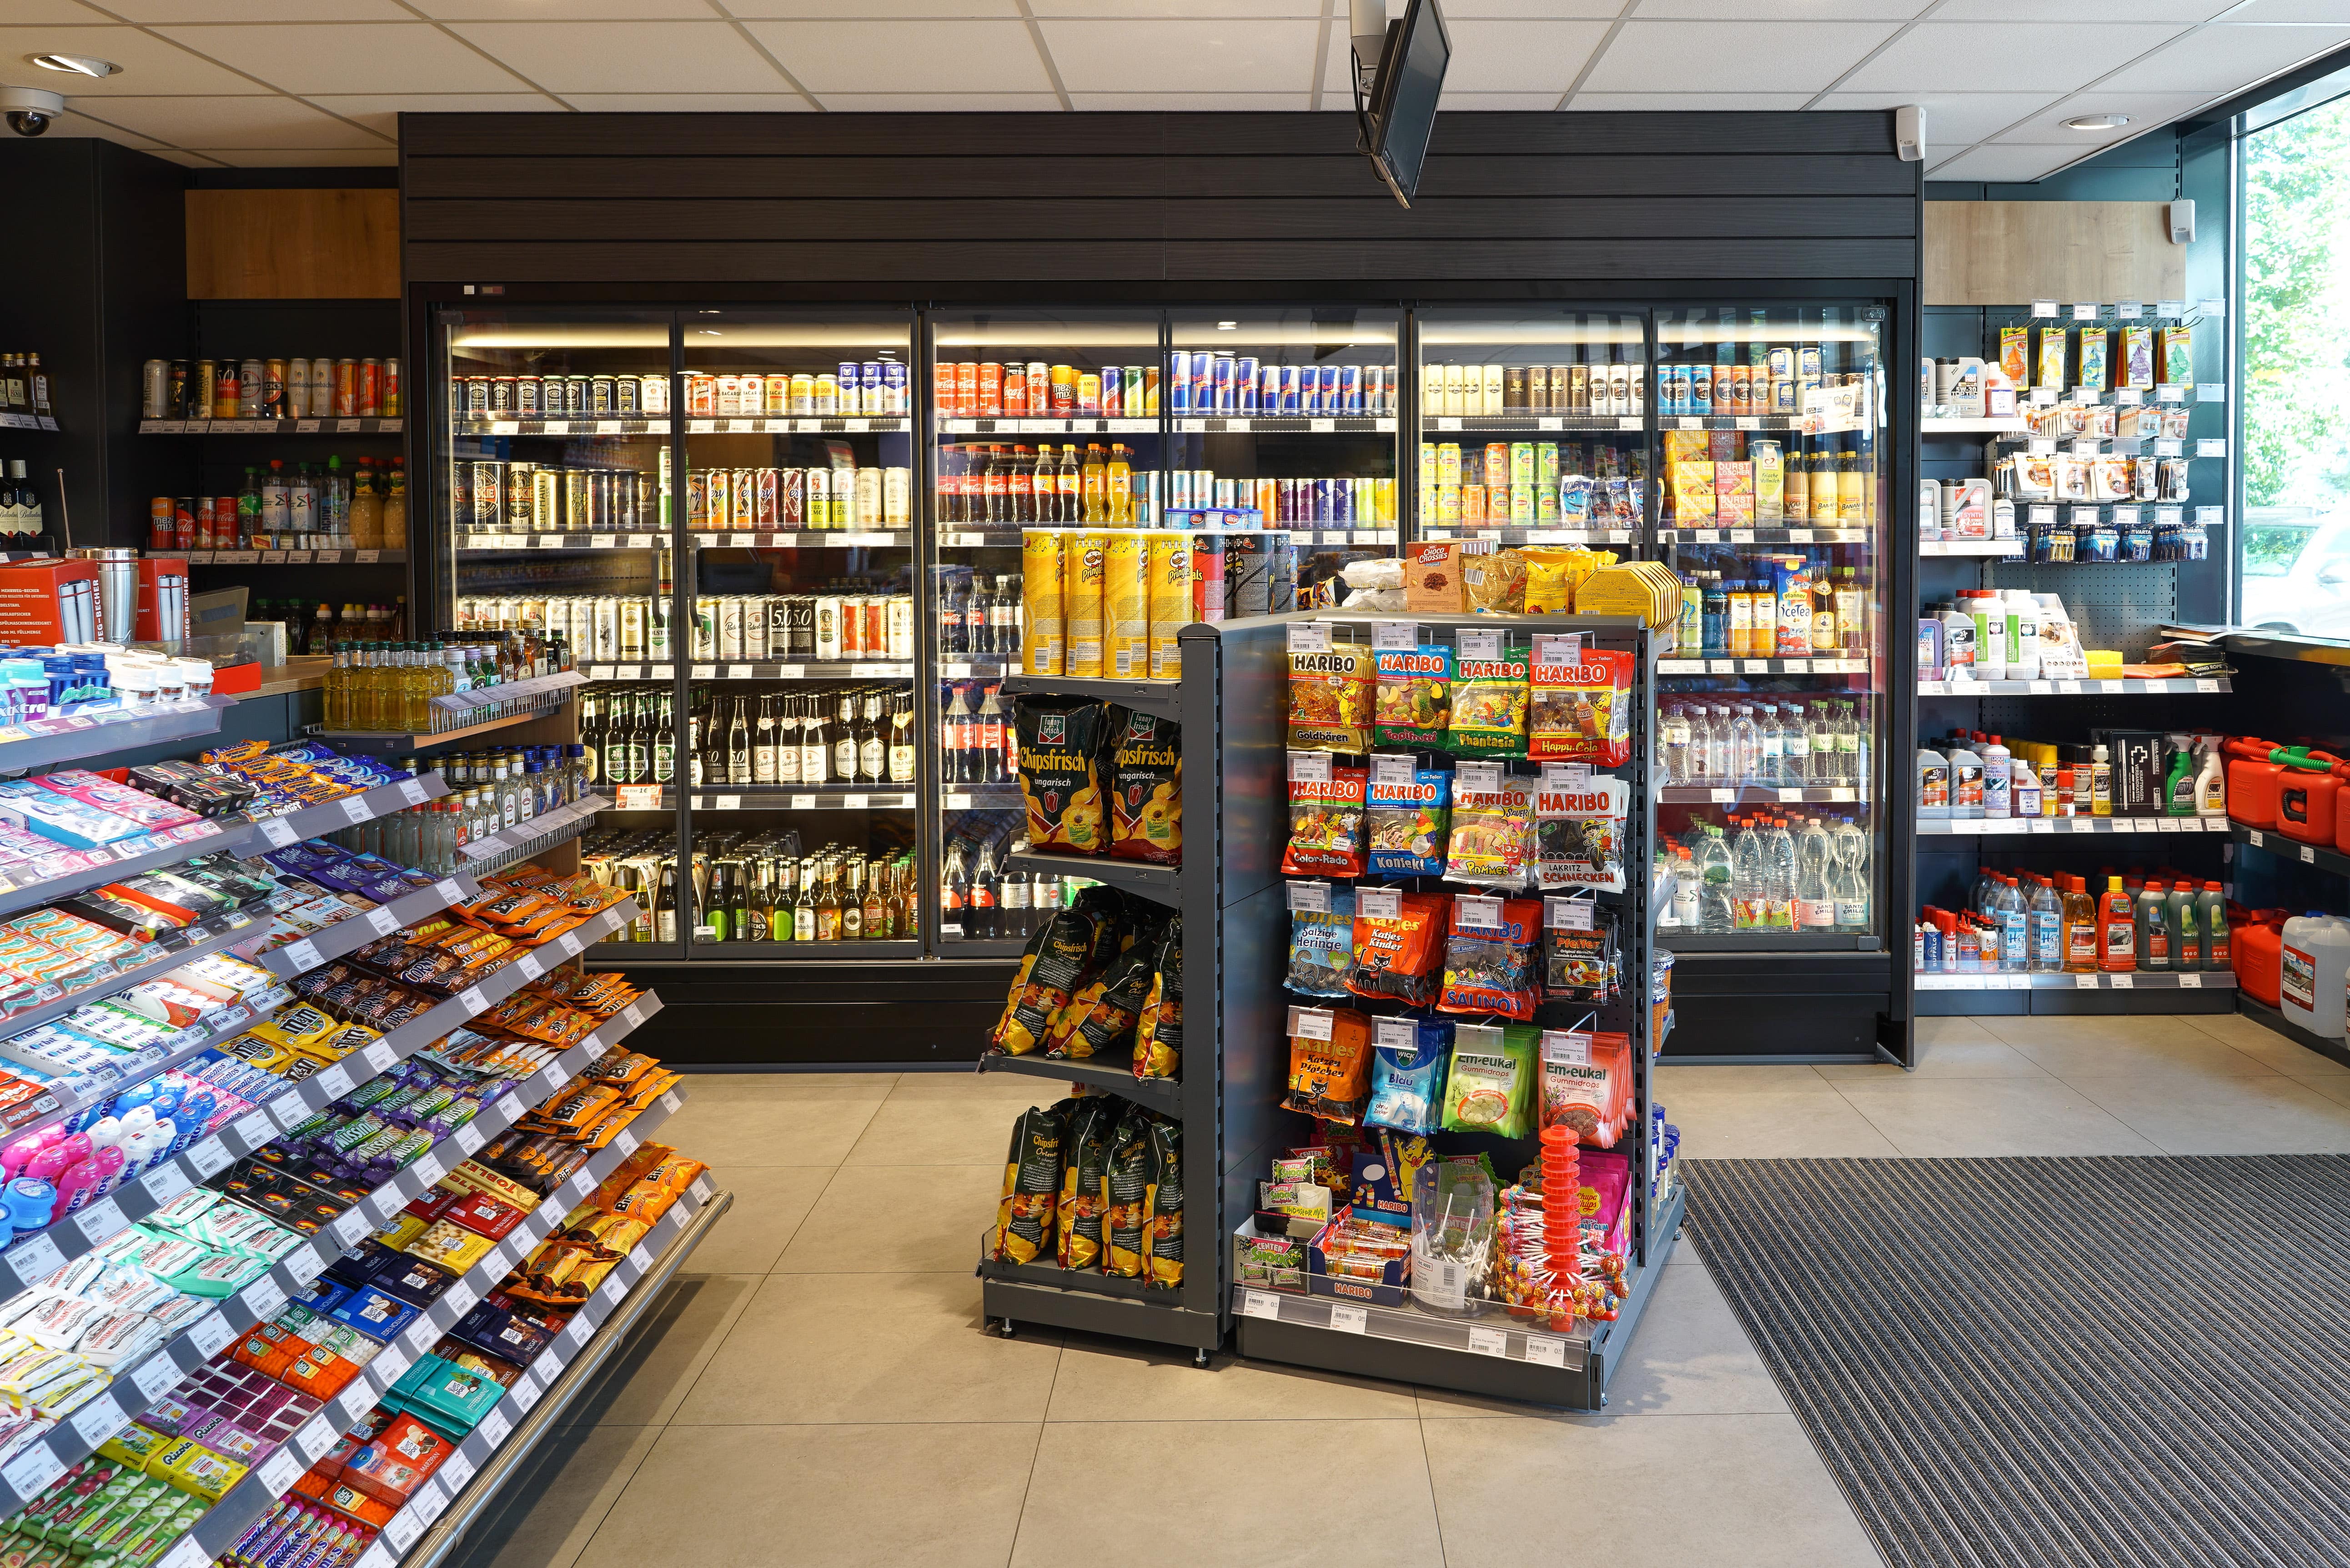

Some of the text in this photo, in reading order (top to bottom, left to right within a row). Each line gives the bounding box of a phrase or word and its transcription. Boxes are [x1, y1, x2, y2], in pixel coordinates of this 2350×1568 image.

[1718, 462, 1749, 471] DURST
[1720, 495, 1751, 504] DURST
[1418, 552, 1448, 564] CROSSIES
[1423, 547, 1445, 556] CHOCO
[1168, 565, 1190, 583] Pringles
[1294, 655, 1356, 672] HARIBO
[1380, 654, 1444, 672] HARIBO
[1459, 662, 1525, 678] HARIBO
[1536, 665, 1605, 682] HARIBO
[1135, 714, 1153, 724] funny-
[1577, 709, 1594, 718] HARIBO
[1043, 725, 1060, 734] frisch
[1044, 717, 1062, 728] funny-
[1133, 721, 1150, 731] frisch
[1296, 730, 1349, 742] Goldbären
[1382, 729, 1437, 742] Tropifrutti
[1459, 734, 1515, 748] Phantasia
[1542, 741, 1598, 753] Happy-Cola
[1020, 745, 1086, 774] Chipsfrisch
[1034, 778, 1071, 787] ungarisch
[1119, 771, 1155, 780] ungarisch
[1296, 781, 1358, 797] HARIBO
[1373, 784, 1436, 800] HARIBO
[1461, 792, 1525, 805] HARIBO
[1538, 792, 1610, 812] HARIBO
[1294, 852, 1348, 865] Color-Rado
[1377, 857, 1426, 871] Konfekt
[1544, 872, 1615, 884] SCHNECKEN
[1294, 910, 1354, 928] Katjes
[1302, 927, 1338, 939] Salzige
[1371, 929, 1405, 942] Katjes-
[1457, 923, 1522, 940] HARIBO
[1053, 940, 1087, 953] Chipsfrisch
[1296, 936, 1342, 952] Heringe
[1368, 937, 1403, 952] Kinder
[1557, 938, 1600, 949] Pfeffer
[1447, 990, 1512, 1012] SALINO
[84, 1014, 109, 1027] Orbit
[102, 1021, 129, 1035] Orbit
[29, 1036, 58, 1050] Orbit
[1297, 1037, 1356, 1059] Katjes
[47, 1043, 74, 1058] Orbit
[1397, 1050, 1415, 1059] WICK
[66, 1051, 93, 1065] Orbit
[1307, 1054, 1341, 1067] Katzen
[1457, 1055, 1517, 1070] Em-eukal
[203, 1063, 227, 1082] mentos
[1300, 1062, 1345, 1078] Pfötchen
[1461, 1065, 1510, 1077] Gummidrops
[1546, 1062, 1607, 1081] Em-eukal
[216, 1068, 240, 1087] mentos
[1389, 1073, 1413, 1086] Blau
[1550, 1076, 1600, 1089] Gummidrops
[243, 1079, 269, 1099] mentos
[1284, 1162, 1302, 1171] CENTER
[1577, 1192, 1598, 1202] Chupa
[1377, 1200, 1408, 1213] HARIBO
[1256, 1241, 1284, 1254] CENTER
[365, 1255, 381, 1269] NUGAT
[1250, 1248, 1289, 1267] SHOCK
[429, 1283, 445, 1297] NUGAT
[1334, 1282, 1373, 1299] HARIBO
[524, 1338, 538, 1352] NUGAT
[193, 1416, 225, 1440] Ricola
[161, 1441, 194, 1466] Ricola
[419, 1451, 441, 1473] MARZIPAN
